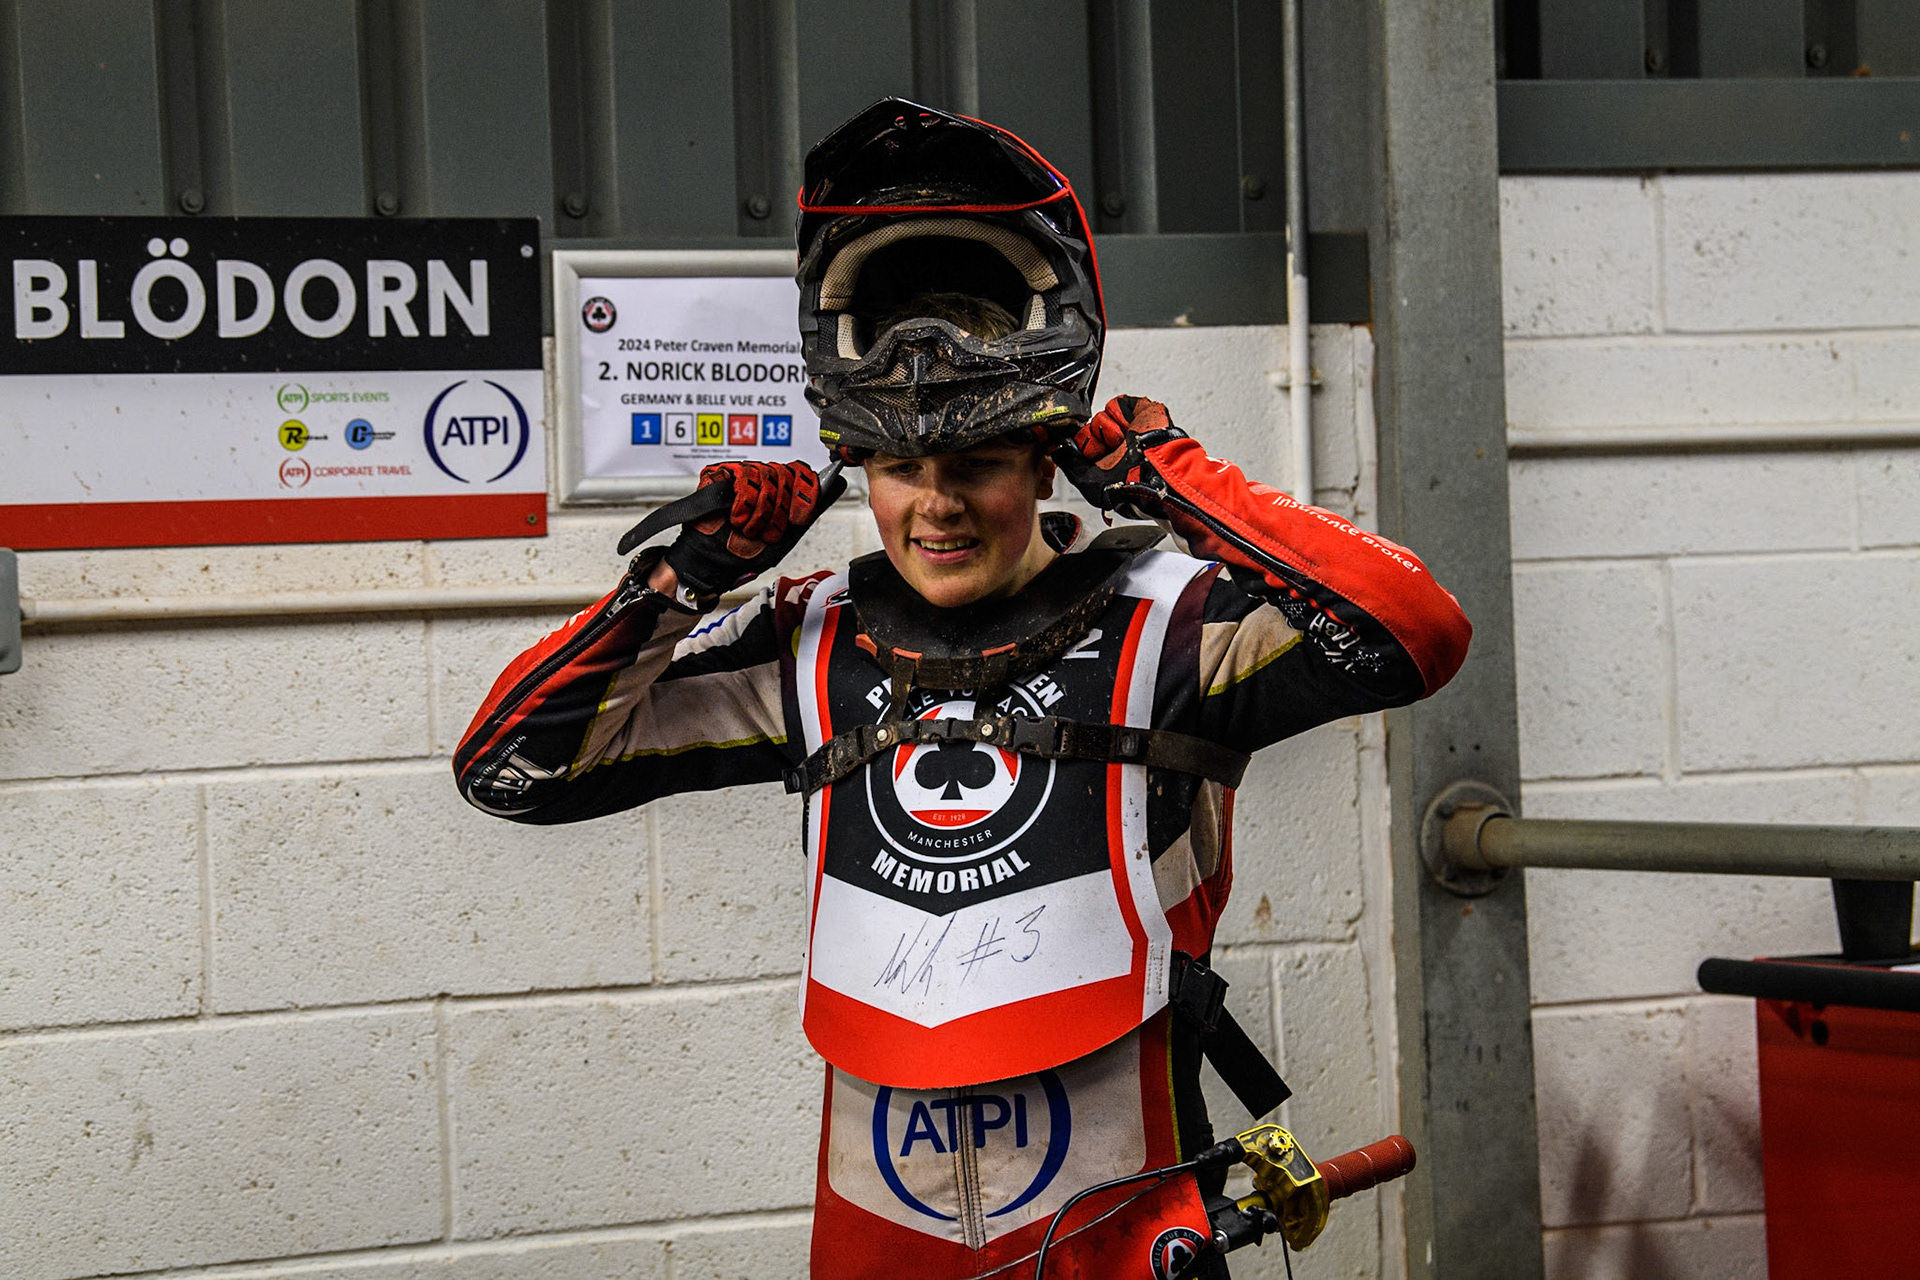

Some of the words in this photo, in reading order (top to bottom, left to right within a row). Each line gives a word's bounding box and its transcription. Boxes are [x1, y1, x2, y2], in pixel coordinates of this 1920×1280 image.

[13, 237, 490, 340] BLÖDORN
[617, 339, 650, 352] 2024
[654, 339, 688, 352] Peter
[691, 340, 733, 353] Craven
[737, 340, 801, 354] Memorial
[598, 362, 618, 381] 2.
[627, 362, 705, 382] NORICK
[311, 393, 350, 403] SPORTS
[352, 392, 390, 402] EVENTS
[620, 394, 682, 406] GERMANY
[684, 395, 694, 406] &
[696, 395, 726, 406] BELLE
[729, 395, 754, 407] VUE
[757, 396, 787, 407] ACES
[442, 416, 509, 447] ATPI
[640, 420, 652, 439] 1
[674, 421, 686, 438] 6
[700, 421, 721, 438] 10
[731, 421, 755, 440] 14
[765, 422, 789, 440] 18
[313, 466, 375, 477] CORPORATE
[377, 465, 413, 476] TRAVEL
[932, 813, 946, 822] EST
[907, 829, 993, 849] MANCHESTER
[871, 848, 1031, 894] MEMORIAL
[900, 1094, 1029, 1157] ATPI
[1163, 1230, 1180, 1241] VUE
